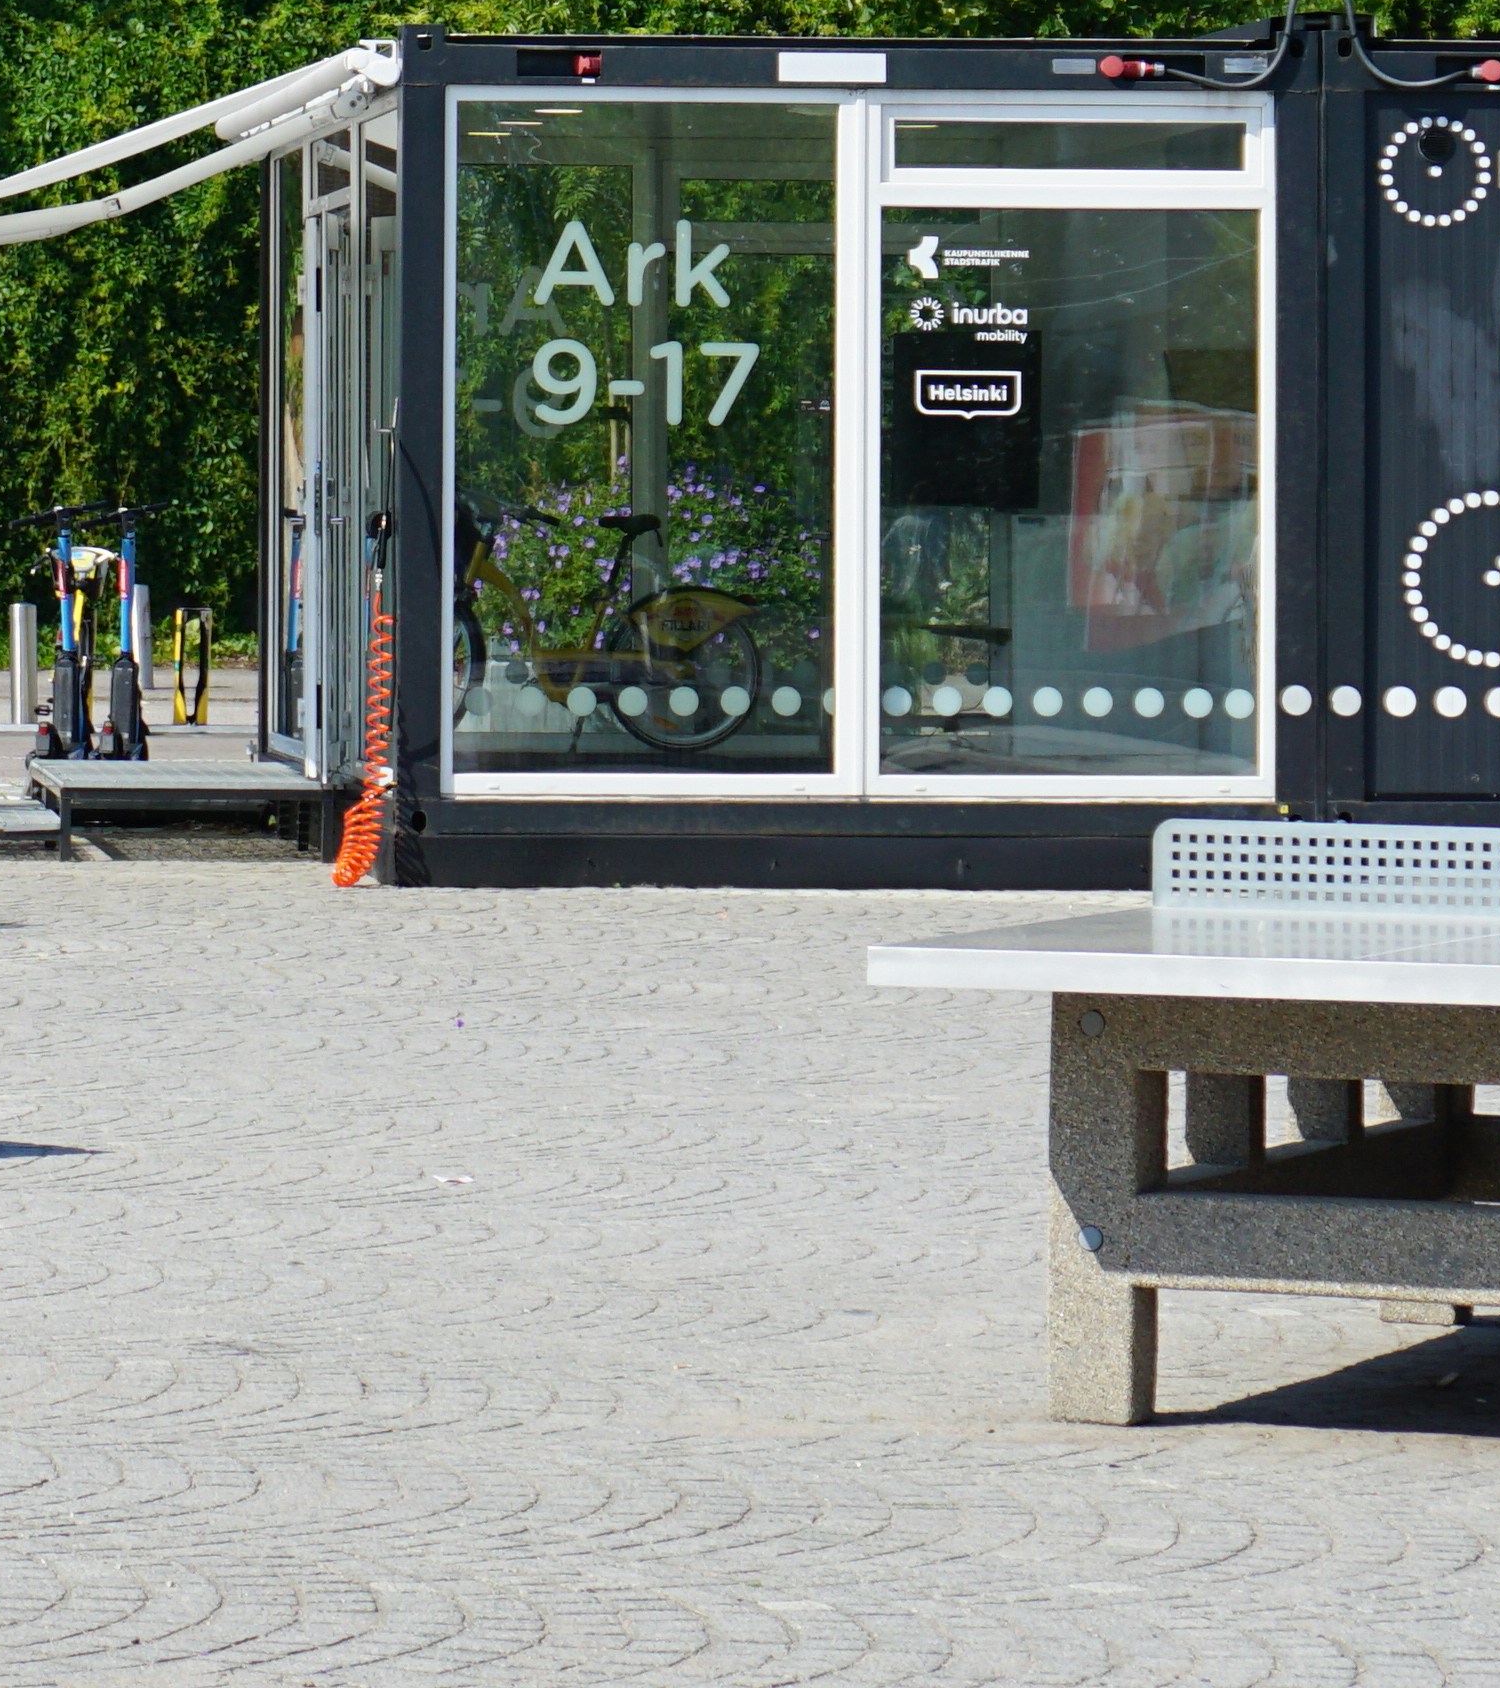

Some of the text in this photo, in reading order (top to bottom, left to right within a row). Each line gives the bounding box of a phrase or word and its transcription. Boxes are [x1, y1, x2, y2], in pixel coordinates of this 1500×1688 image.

[533, 218, 731, 308] Ark
[943, 249, 1030, 258] KAUPUNKILIIKENNE
[943, 258, 1000, 266] STADSTRAFIK
[951, 301, 1028, 325] inurba
[975, 329, 1028, 344] mobility
[532, 338, 760, 426] 9-17
[927, 383, 1008, 402] Helsinki
